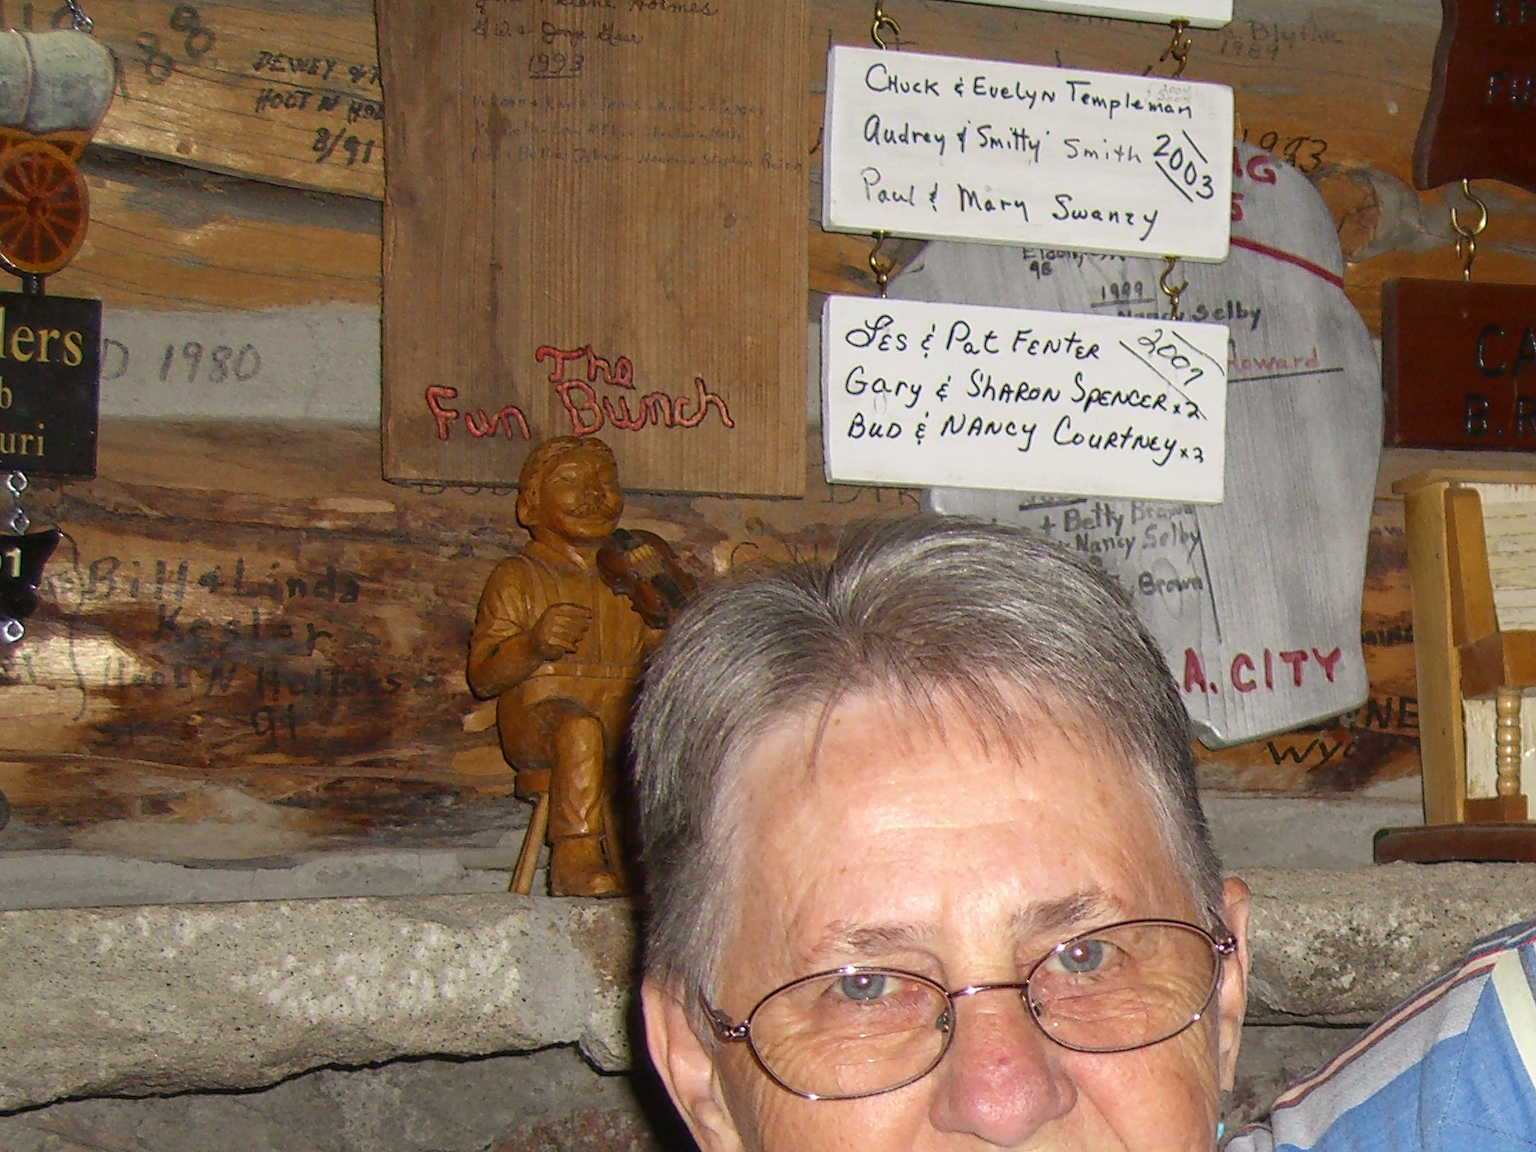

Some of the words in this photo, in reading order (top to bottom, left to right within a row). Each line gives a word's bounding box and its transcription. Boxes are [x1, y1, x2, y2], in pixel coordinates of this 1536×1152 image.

[252, 50, 338, 81] DEWEY
[255, 88, 314, 113] HOOT
[953, 76, 966, 98] &
[1066, 80, 1192, 120] Templeman
[312, 127, 376, 166] 8/91
[864, 114, 946, 156] Audrey
[1064, 138, 1142, 164] Smith
[1152, 133, 1215, 200] 2003
[861, 167, 916, 207] Paul
[928, 182, 939, 213] &
[957, 183, 1030, 222] Mary
[1191, 300, 1261, 331] Selby
[921, 323, 936, 358] &
[946, 320, 1000, 356] Pat
[1137, 328, 1204, 386] 2007
[159, 339, 262, 385] 1980
[845, 365, 922, 408] Gary
[935, 375, 951, 402] &
[425, 385, 532, 441] Fun
[555, 377, 735, 440] Bunch
[915, 411, 930, 446] &
[1064, 501, 1125, 537] Betty
[1075, 533, 1137, 560] Nancy
[1141, 521, 1200, 564] Selby
[87, 556, 189, 602] Bill
[234, 556, 361, 604] Linda
[1138, 570, 1204, 597] Brown
[1230, 646, 1342, 693] CITY
